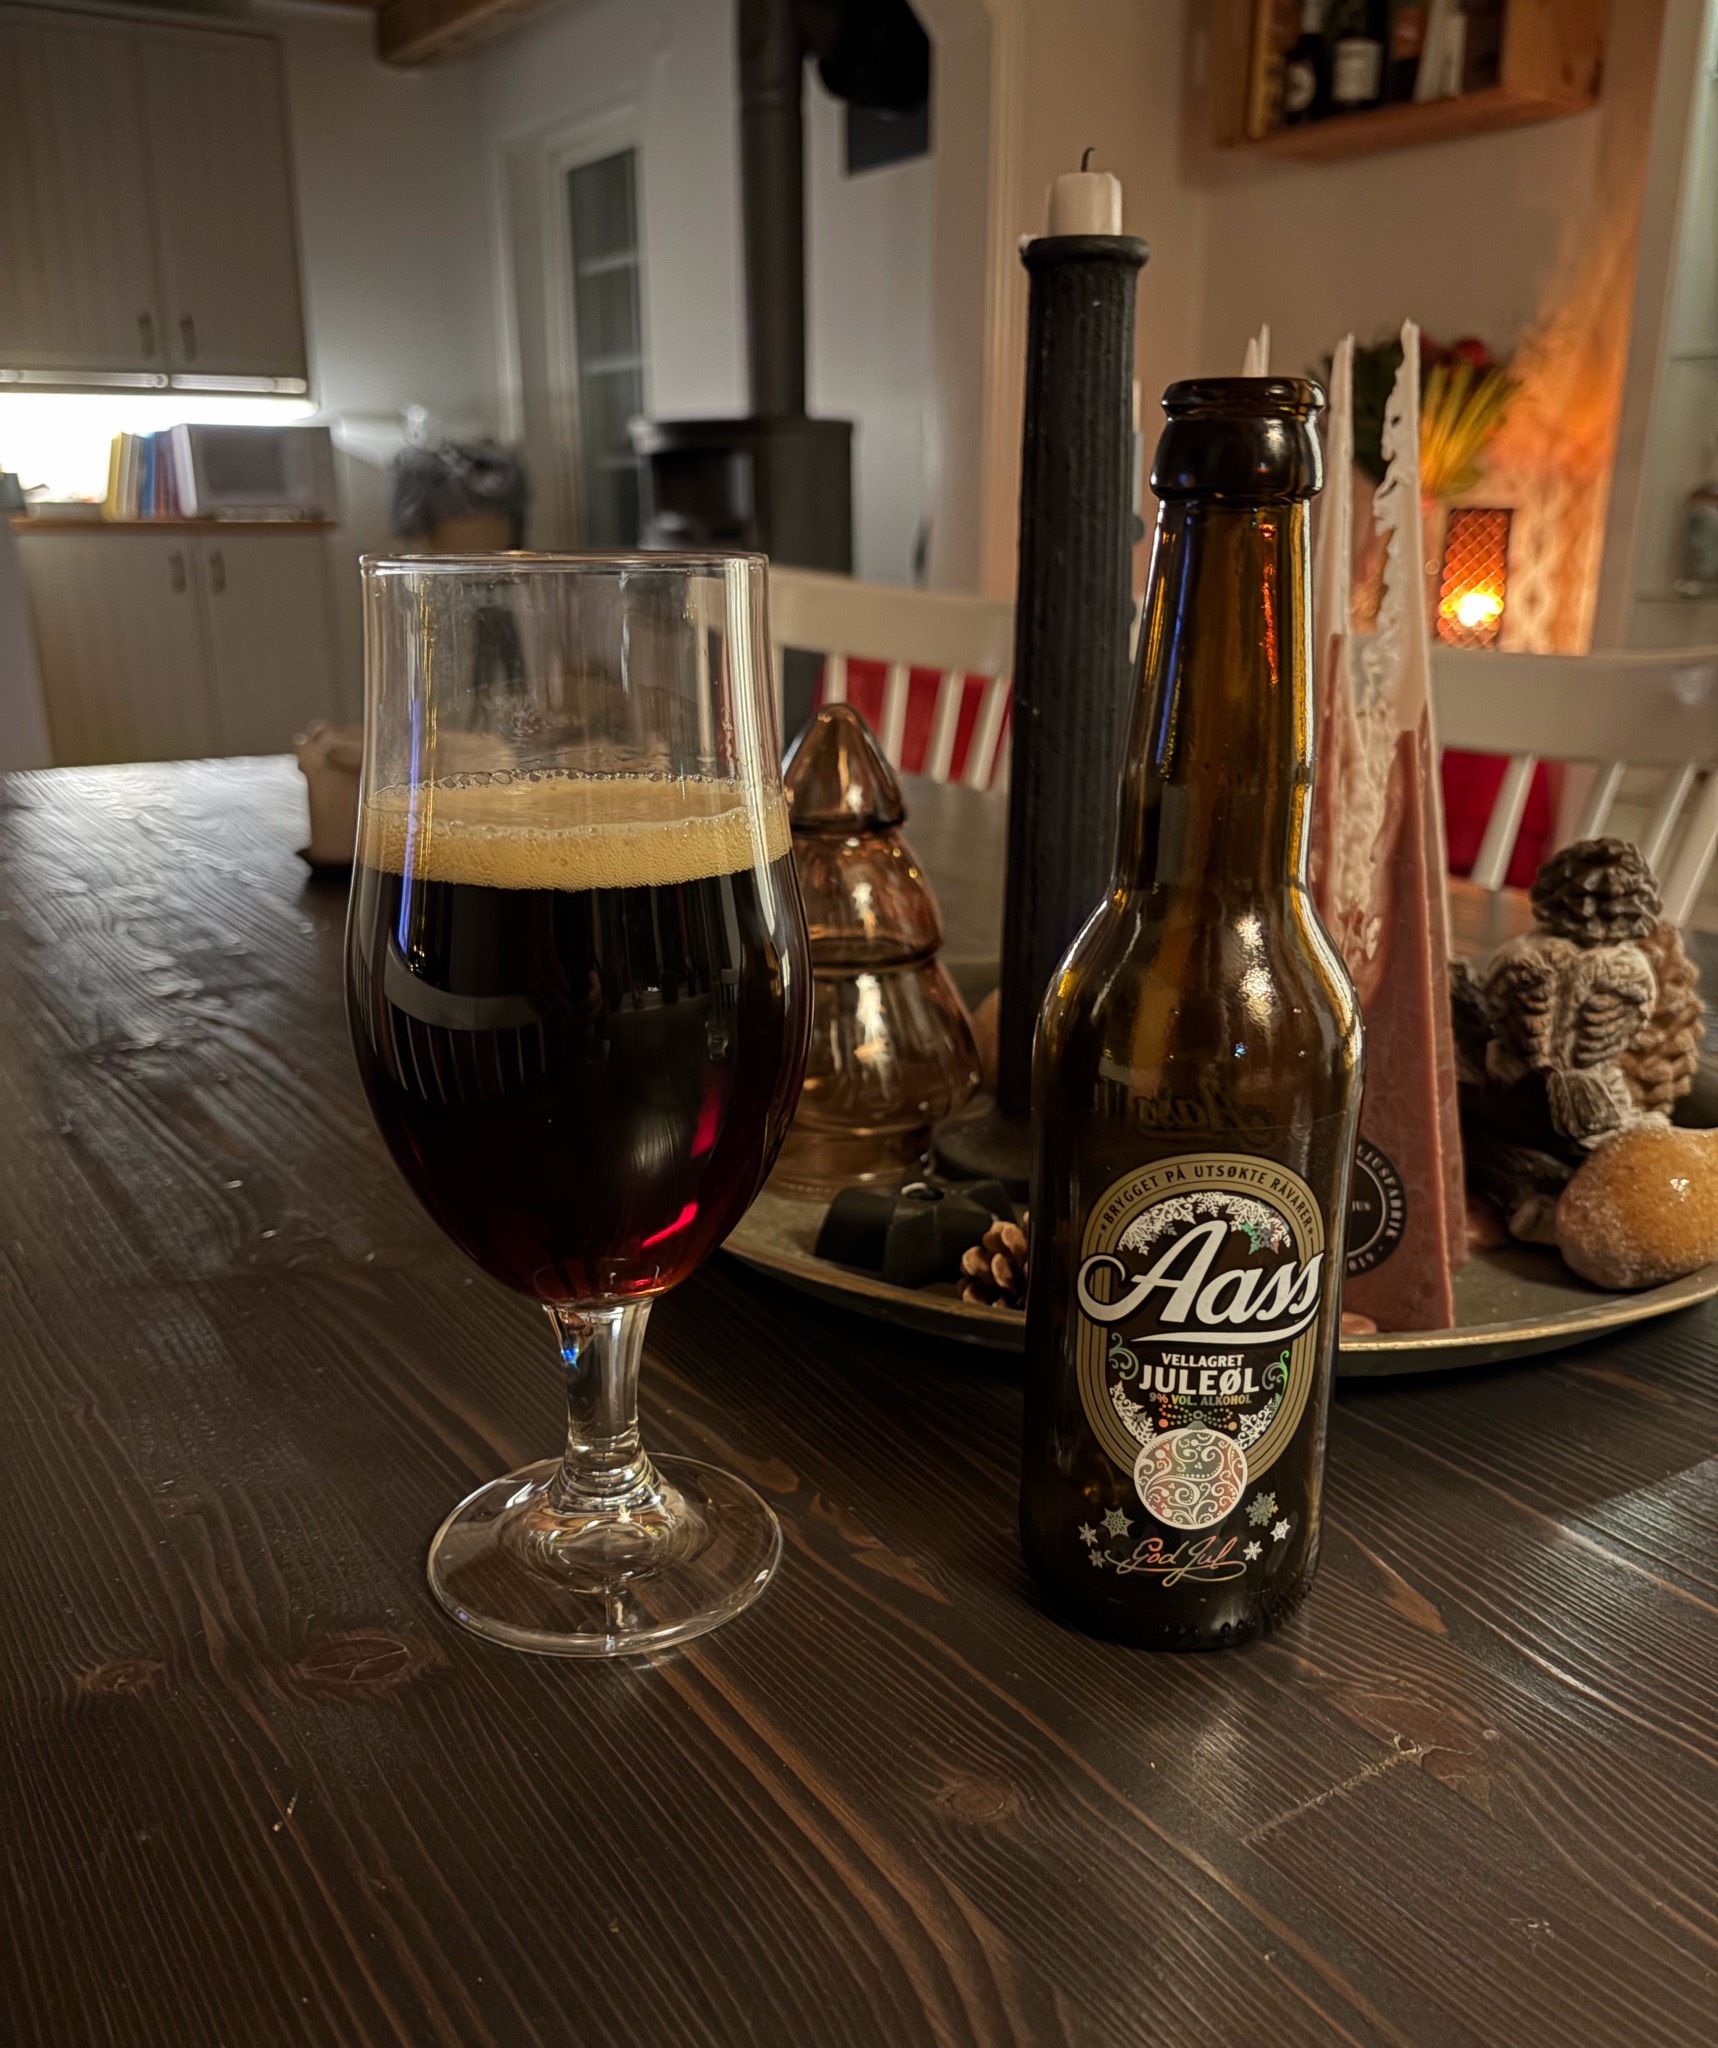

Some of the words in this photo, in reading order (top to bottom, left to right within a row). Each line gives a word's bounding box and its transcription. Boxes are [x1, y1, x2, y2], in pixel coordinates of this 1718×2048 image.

[1103, 1175, 1159, 1225] BRYGGET
[1164, 1163, 1187, 1183] PÅ
[1194, 1164, 1268, 1185] UTSØKTE
[1269, 1178, 1314, 1228] RÅVARER
[1077, 1220, 1324, 1328] Aass
[1138, 1364, 1260, 1396] JULEØL
[1161, 1352, 1245, 1368] VELLAGRET
[1148, 1391, 1169, 1404] 9%
[1171, 1394, 1198, 1406] VOL.
[1200, 1393, 1252, 1406] ALKOHOL
[1116, 1536, 1190, 1573] God
[1162, 1535, 1246, 1587] Jul
